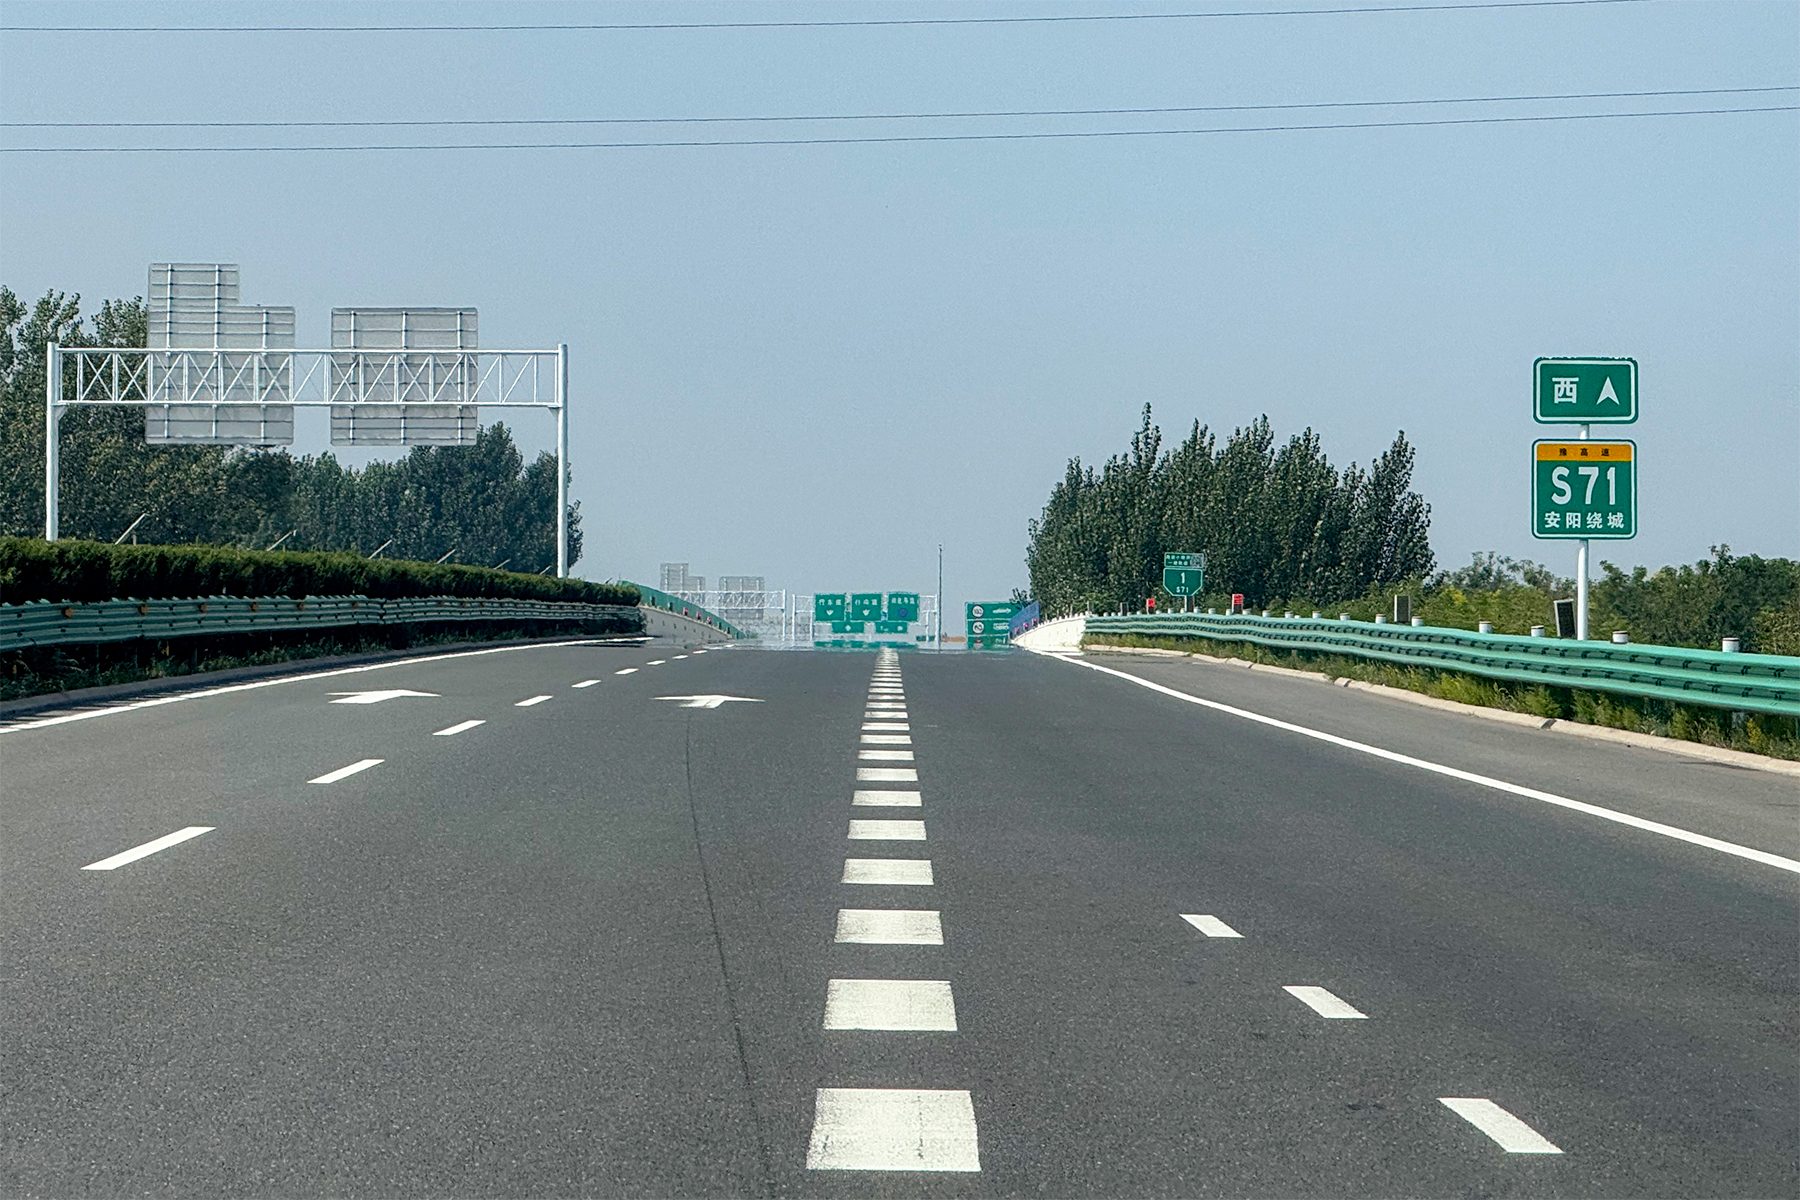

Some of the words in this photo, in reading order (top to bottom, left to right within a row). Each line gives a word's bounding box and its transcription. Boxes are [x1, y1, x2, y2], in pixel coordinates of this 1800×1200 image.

[1551, 377, 1579, 404] 西
[1551, 466, 1616, 505] S71
[1544, 511, 1625, 529] 安阳绕城
